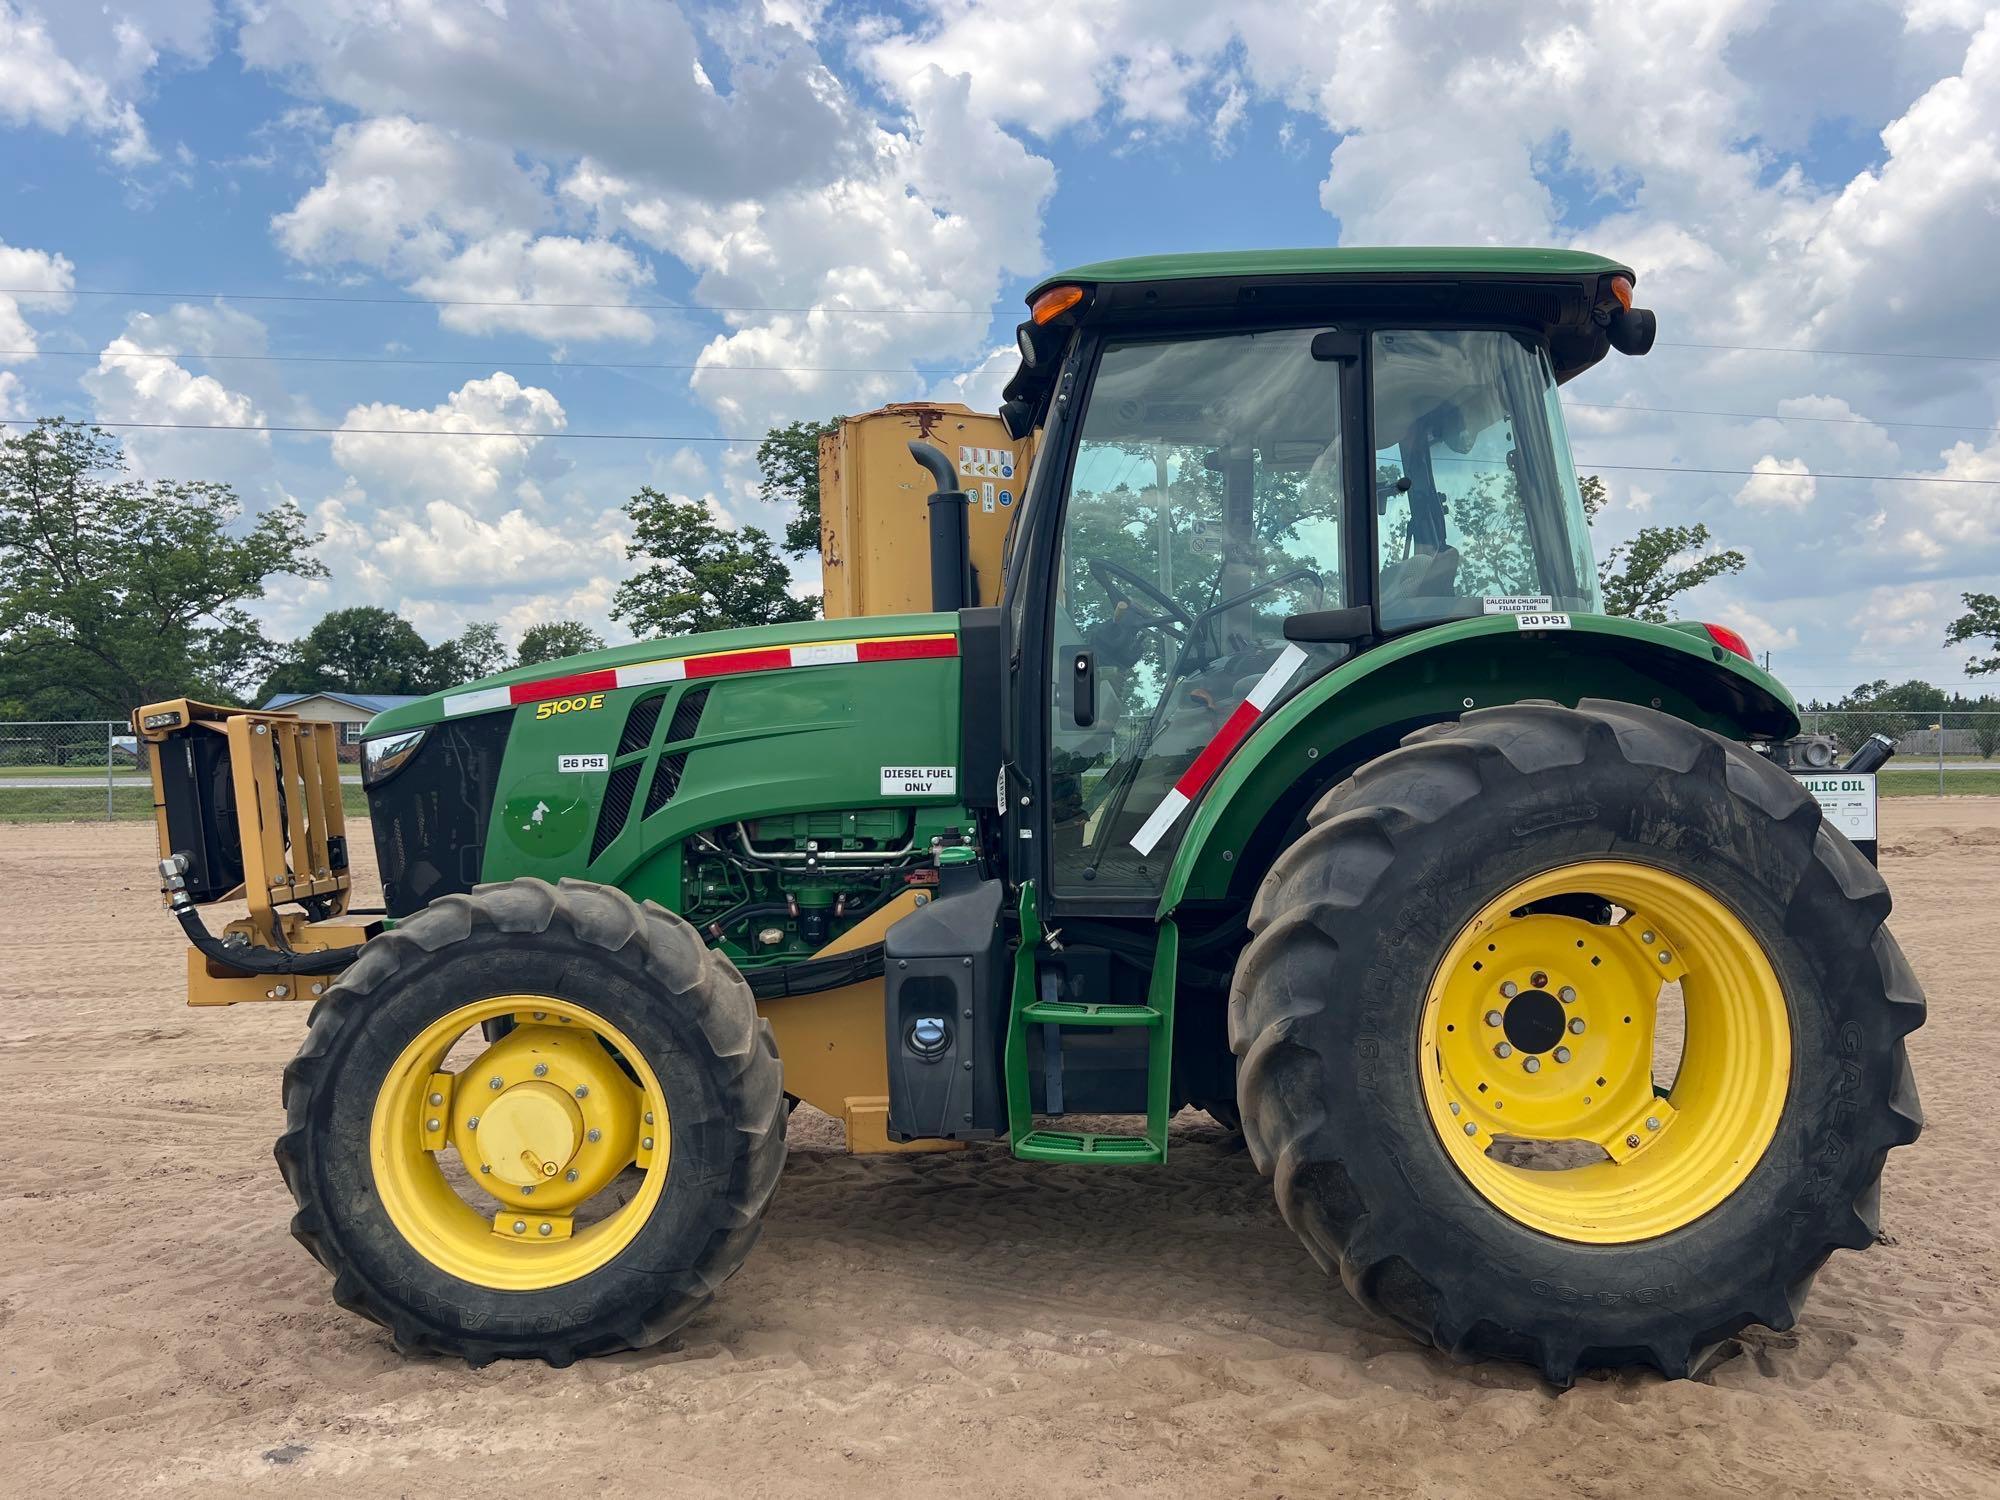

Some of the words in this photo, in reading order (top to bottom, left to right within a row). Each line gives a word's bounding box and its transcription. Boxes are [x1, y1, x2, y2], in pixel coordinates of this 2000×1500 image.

[1521, 616, 1539, 625] 20
[1543, 615, 1566, 624] PSI
[536, 697, 588, 720] 5100
[563, 758, 579, 768] 26
[582, 758, 604, 767] PSI
[884, 769, 924, 778] DIESEL
[926, 769, 953, 778] FUEL
[904, 783, 933, 792] ONLY
[1841, 780, 1865, 791] OIL
[1778, 1020, 1862, 1230] GALAXY
